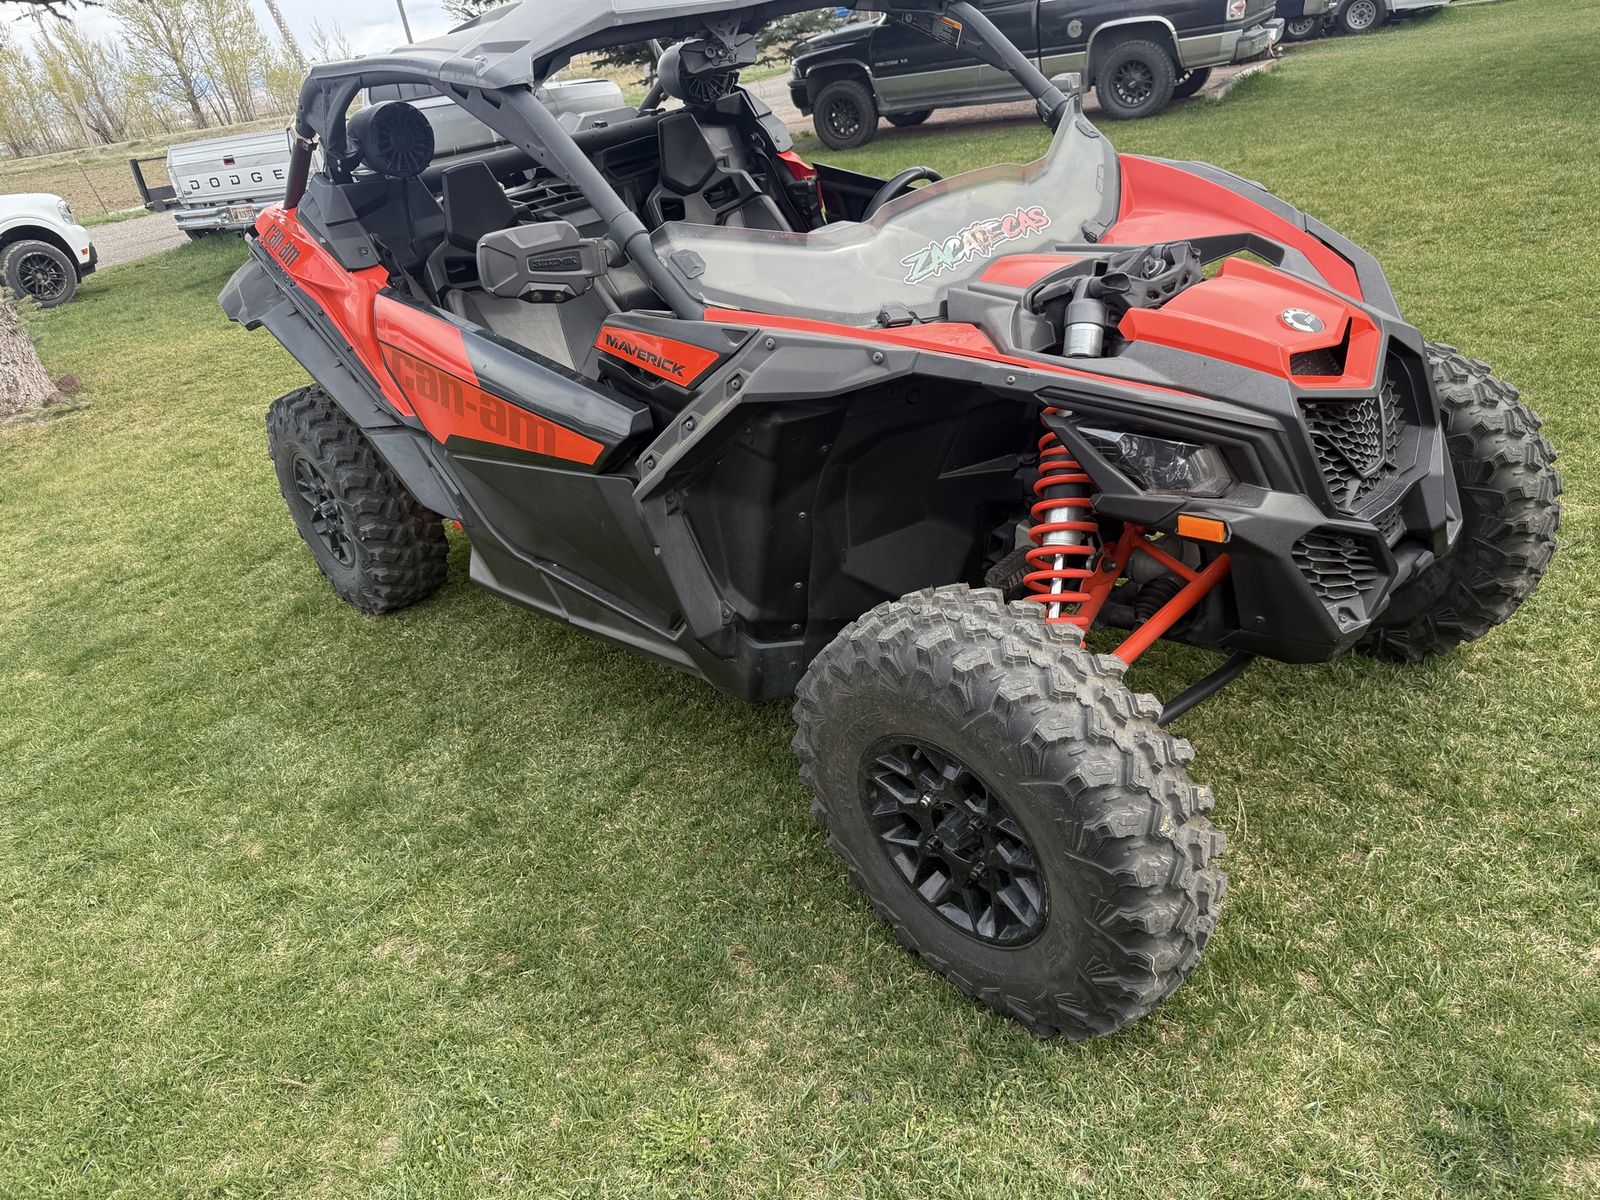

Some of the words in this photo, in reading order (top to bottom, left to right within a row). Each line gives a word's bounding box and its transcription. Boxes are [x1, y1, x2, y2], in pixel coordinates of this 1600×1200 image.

[188, 169, 285, 190] DODGE
[604, 334, 686, 377] MAVERICK
[391, 350, 556, 456] can-am
